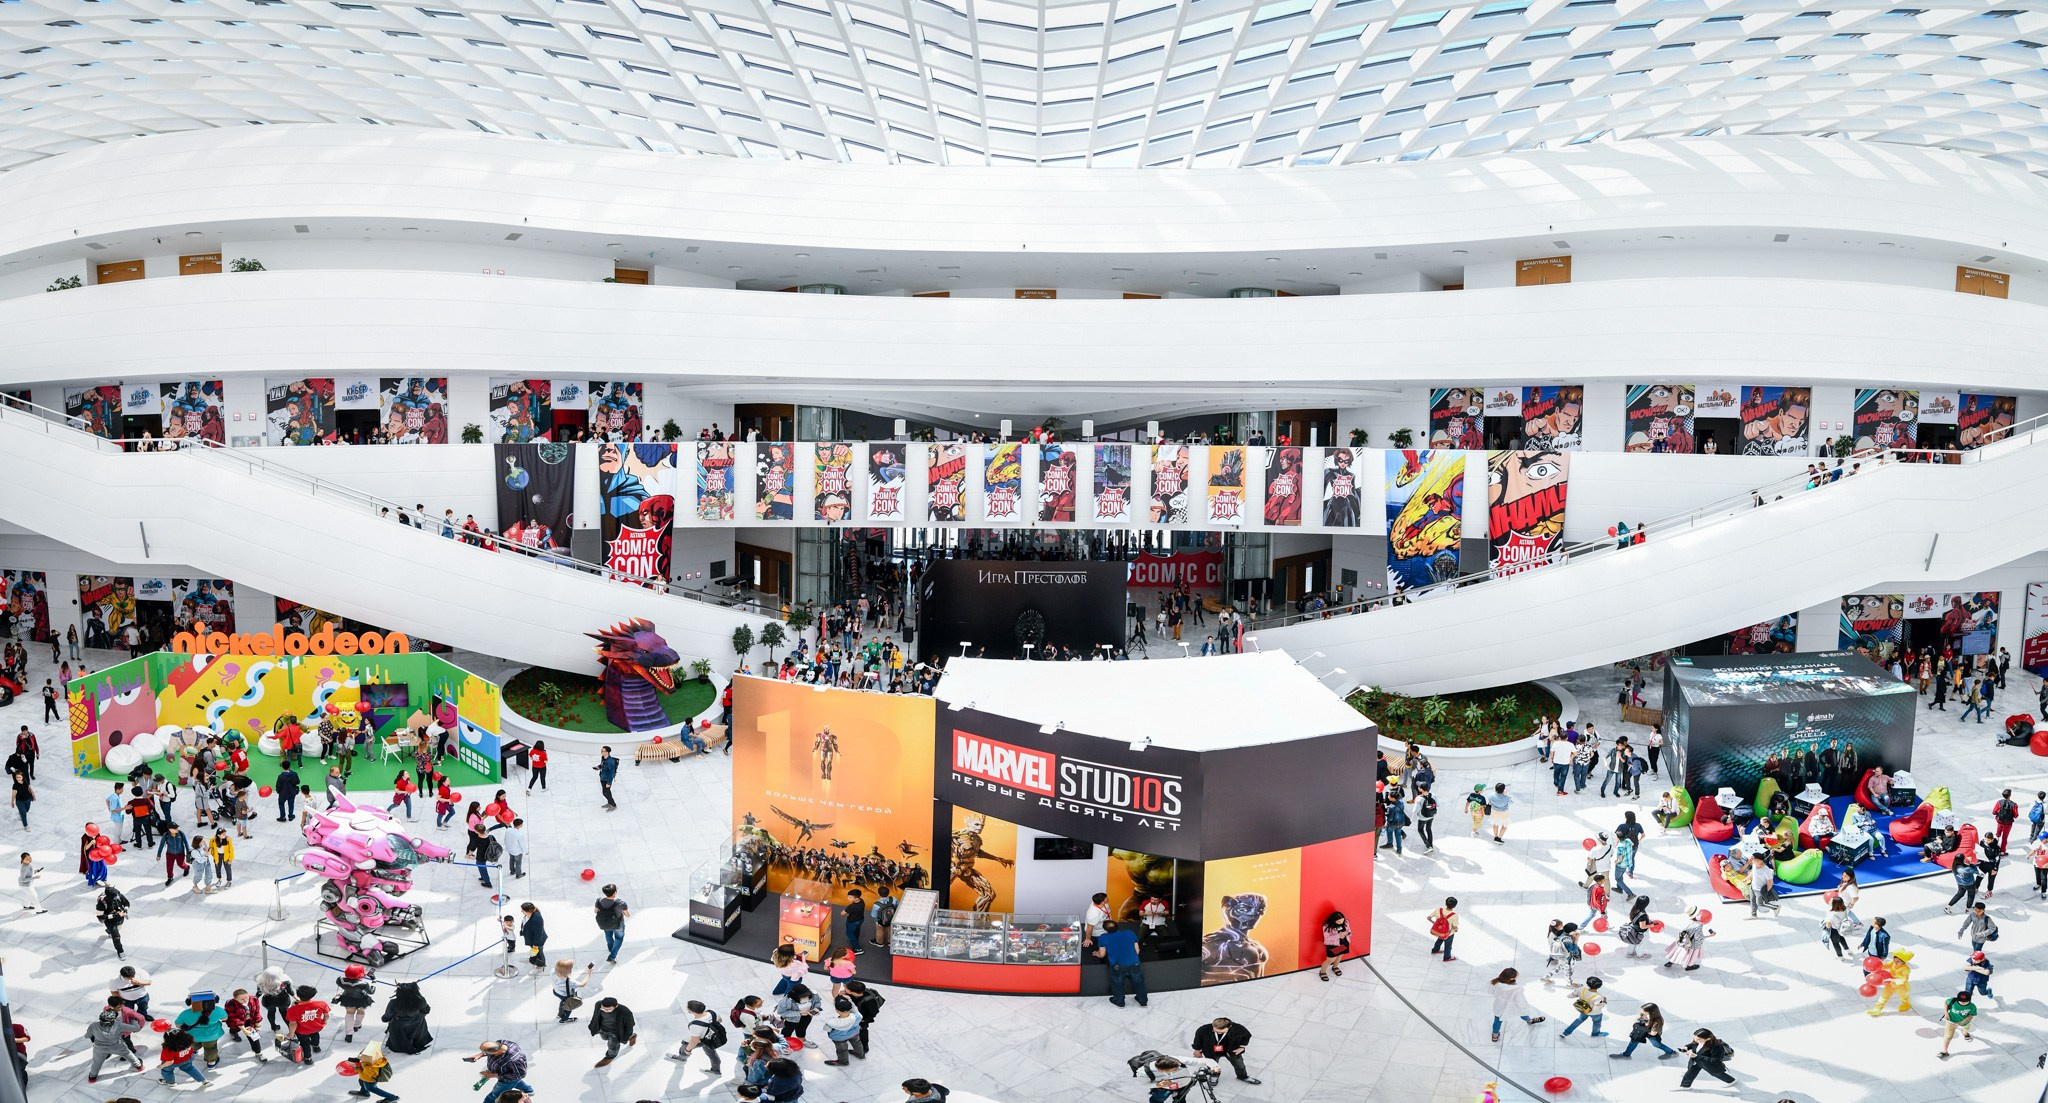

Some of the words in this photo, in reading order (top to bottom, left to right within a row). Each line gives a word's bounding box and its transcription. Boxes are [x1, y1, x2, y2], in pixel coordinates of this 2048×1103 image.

[1878, 433, 1892, 443] CON
[709, 480, 722, 489] CON
[768, 480, 782, 488] CON
[824, 480, 842, 491] CON
[1047, 479, 1066, 490] CON
[1159, 481, 1178, 492] CON
[1276, 486, 1291, 494] CON
[1335, 486, 1350, 495] CON
[937, 492, 956, 504] CON
[876, 500, 894, 511] CON
[992, 501, 1011, 512] CON
[1102, 502, 1120, 513] CON
[1216, 504, 1234, 514] CON
[1490, 484, 1567, 540] WHAM!
[615, 556, 653, 580] CON
[979, 570, 1011, 584] ИГРА
[1014, 571, 1087, 584] ПРЕСТОЛОВ
[173, 622, 409, 656] nickelodeon
[1778, 667, 1844, 675] SCI-FI
[958, 736, 1051, 791] MARVEL
[766, 790, 814, 804] БОЛЬШЕ
[850, 804, 892, 814] ГЕРОЙ
[952, 773, 1025, 800] ПЕРВЫЕ
[1038, 797, 1124, 822] ДЕСЯТЬ
[1138, 818, 1180, 831] ЛЕТ
